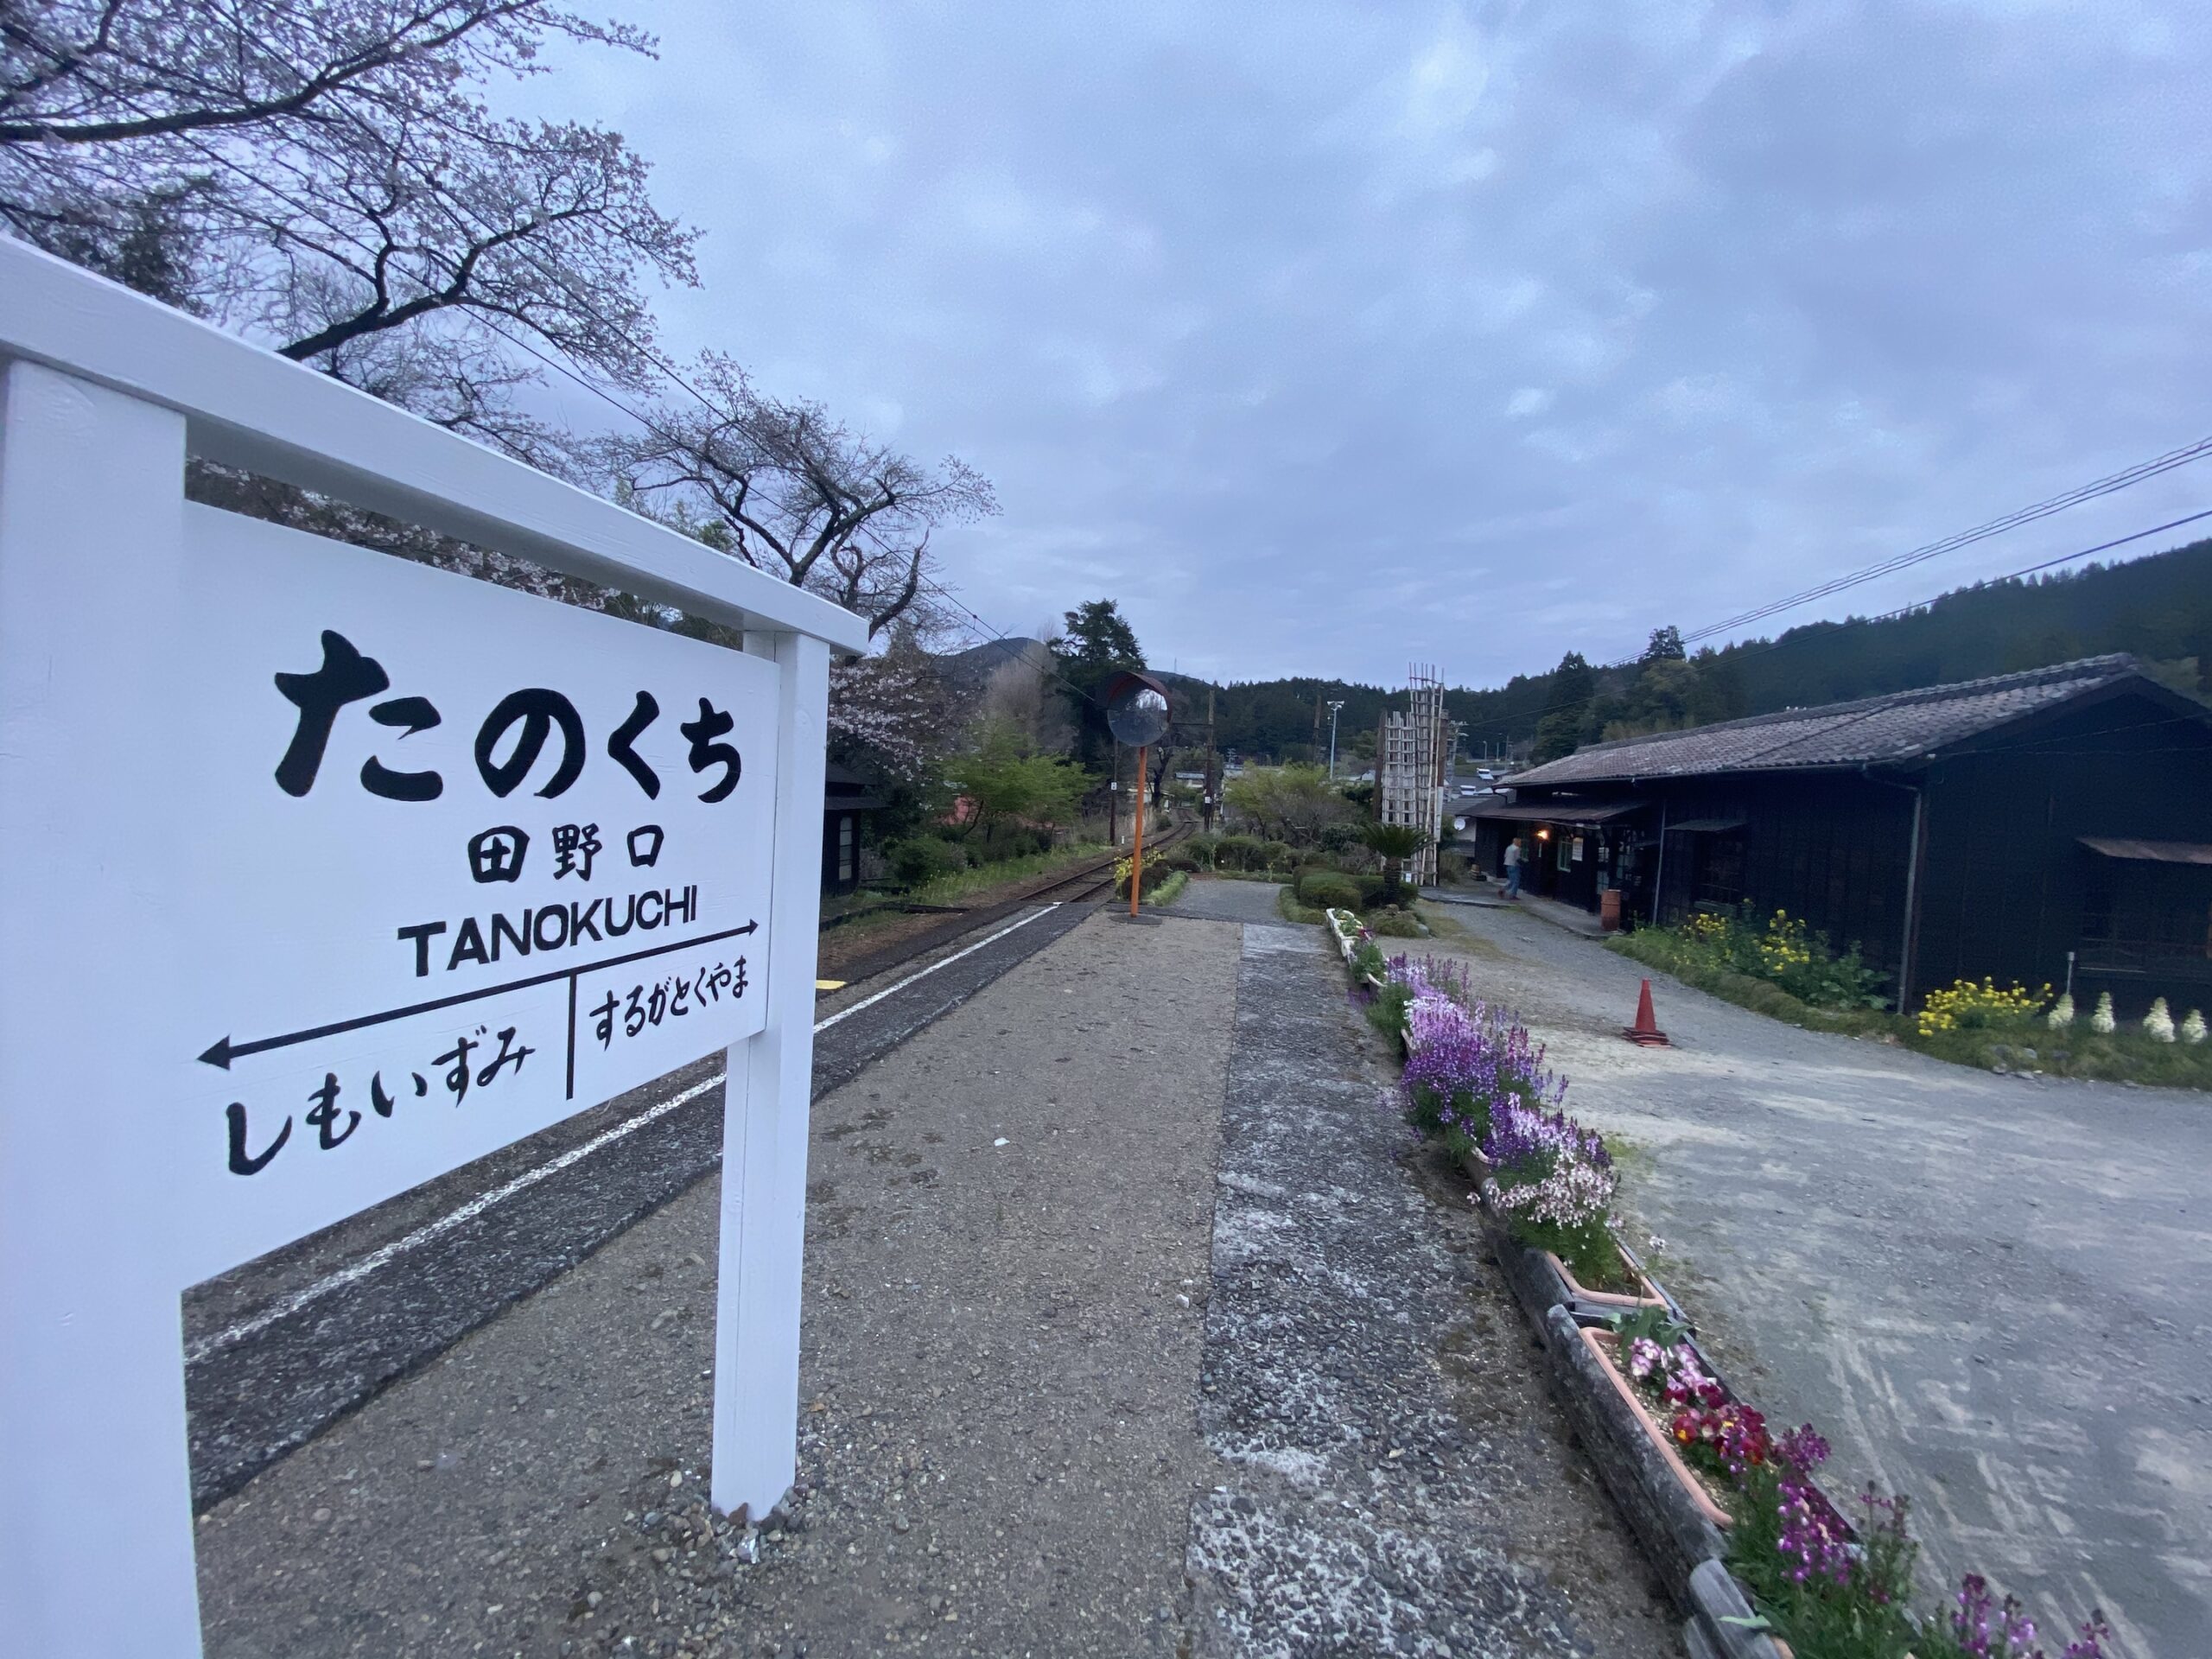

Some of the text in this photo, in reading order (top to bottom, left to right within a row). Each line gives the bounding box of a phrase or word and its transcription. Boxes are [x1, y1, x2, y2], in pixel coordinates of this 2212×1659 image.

[275, 629, 741, 804] たのくち
[467, 823, 664, 883] 田野口
[397, 885, 697, 977] TANOKUCHI
[589, 955, 749, 1052] するがとくやま
[226, 1025, 536, 1176] しもいずみ
